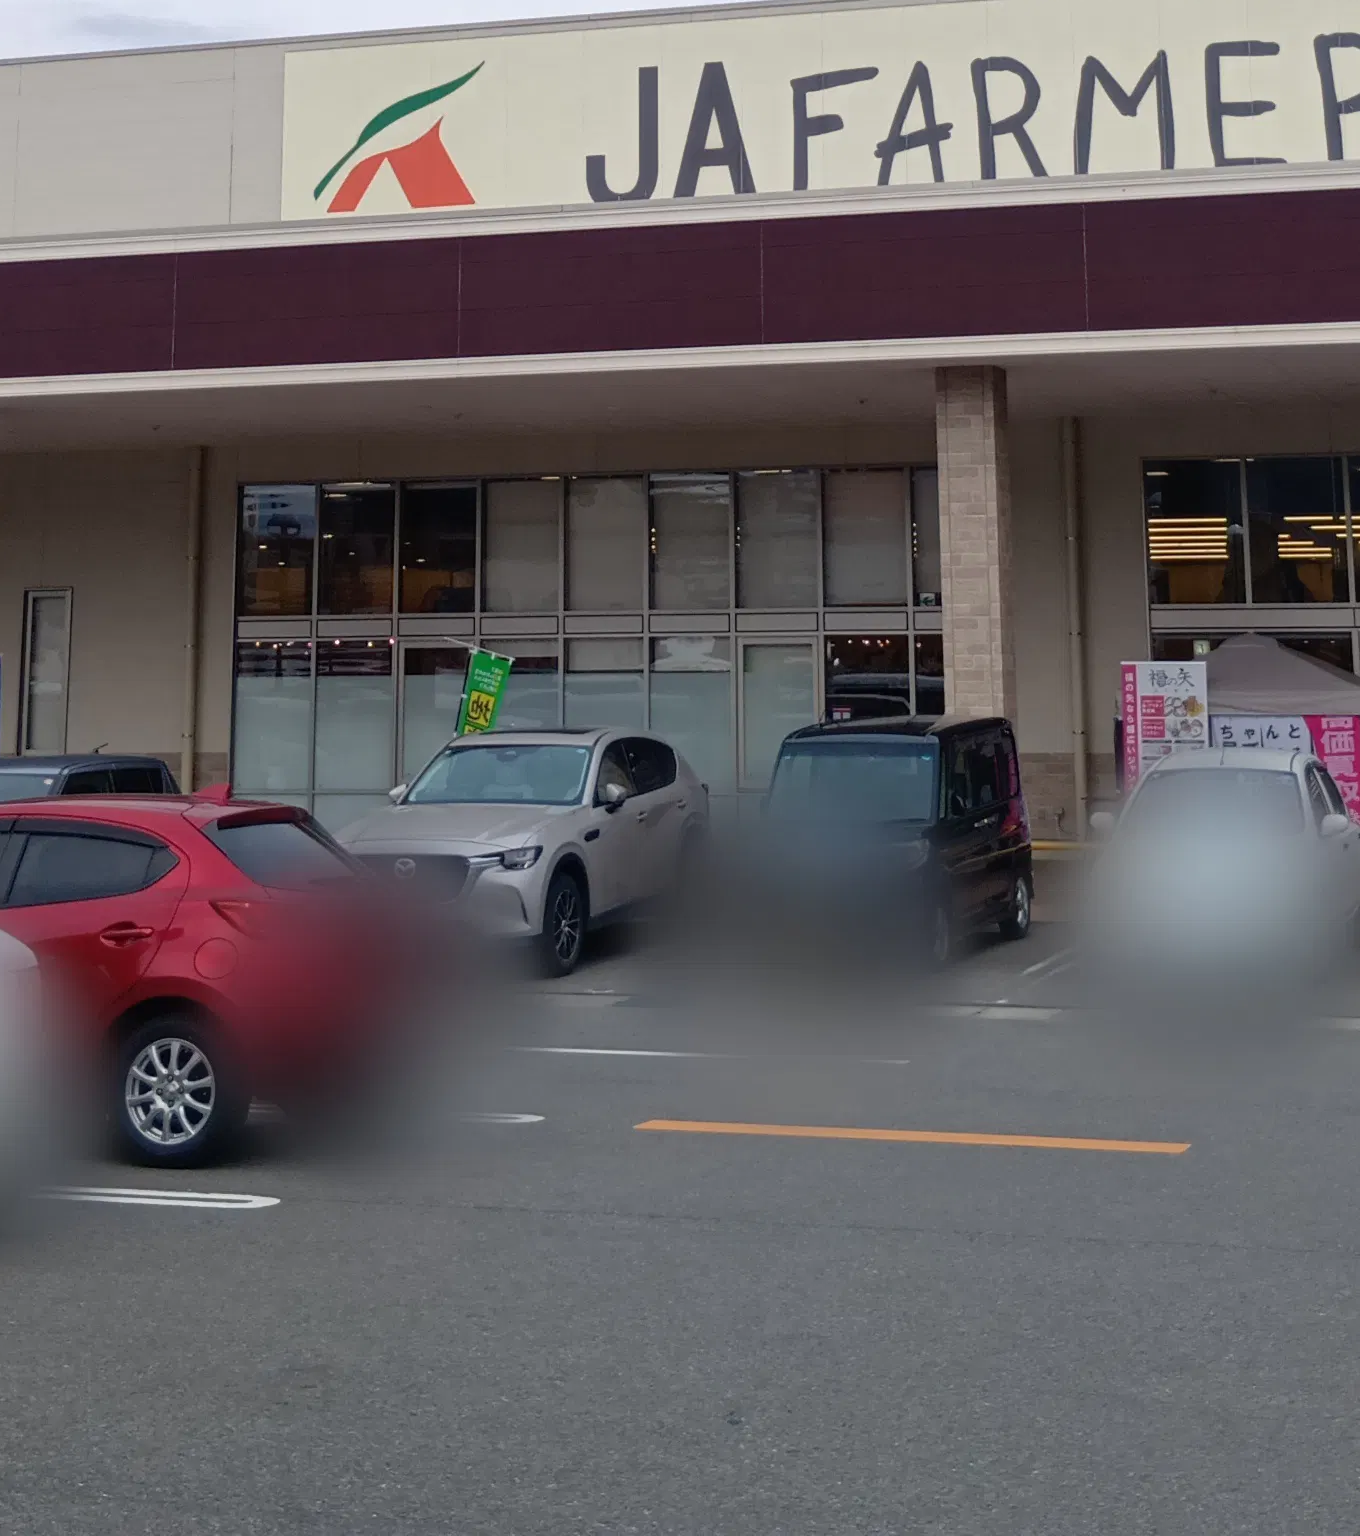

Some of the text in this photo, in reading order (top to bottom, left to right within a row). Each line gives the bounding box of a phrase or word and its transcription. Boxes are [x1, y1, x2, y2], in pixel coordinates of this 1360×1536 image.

[585, 61, 757, 203] JA
[1221, 724, 1301, 740] ちゃんと
